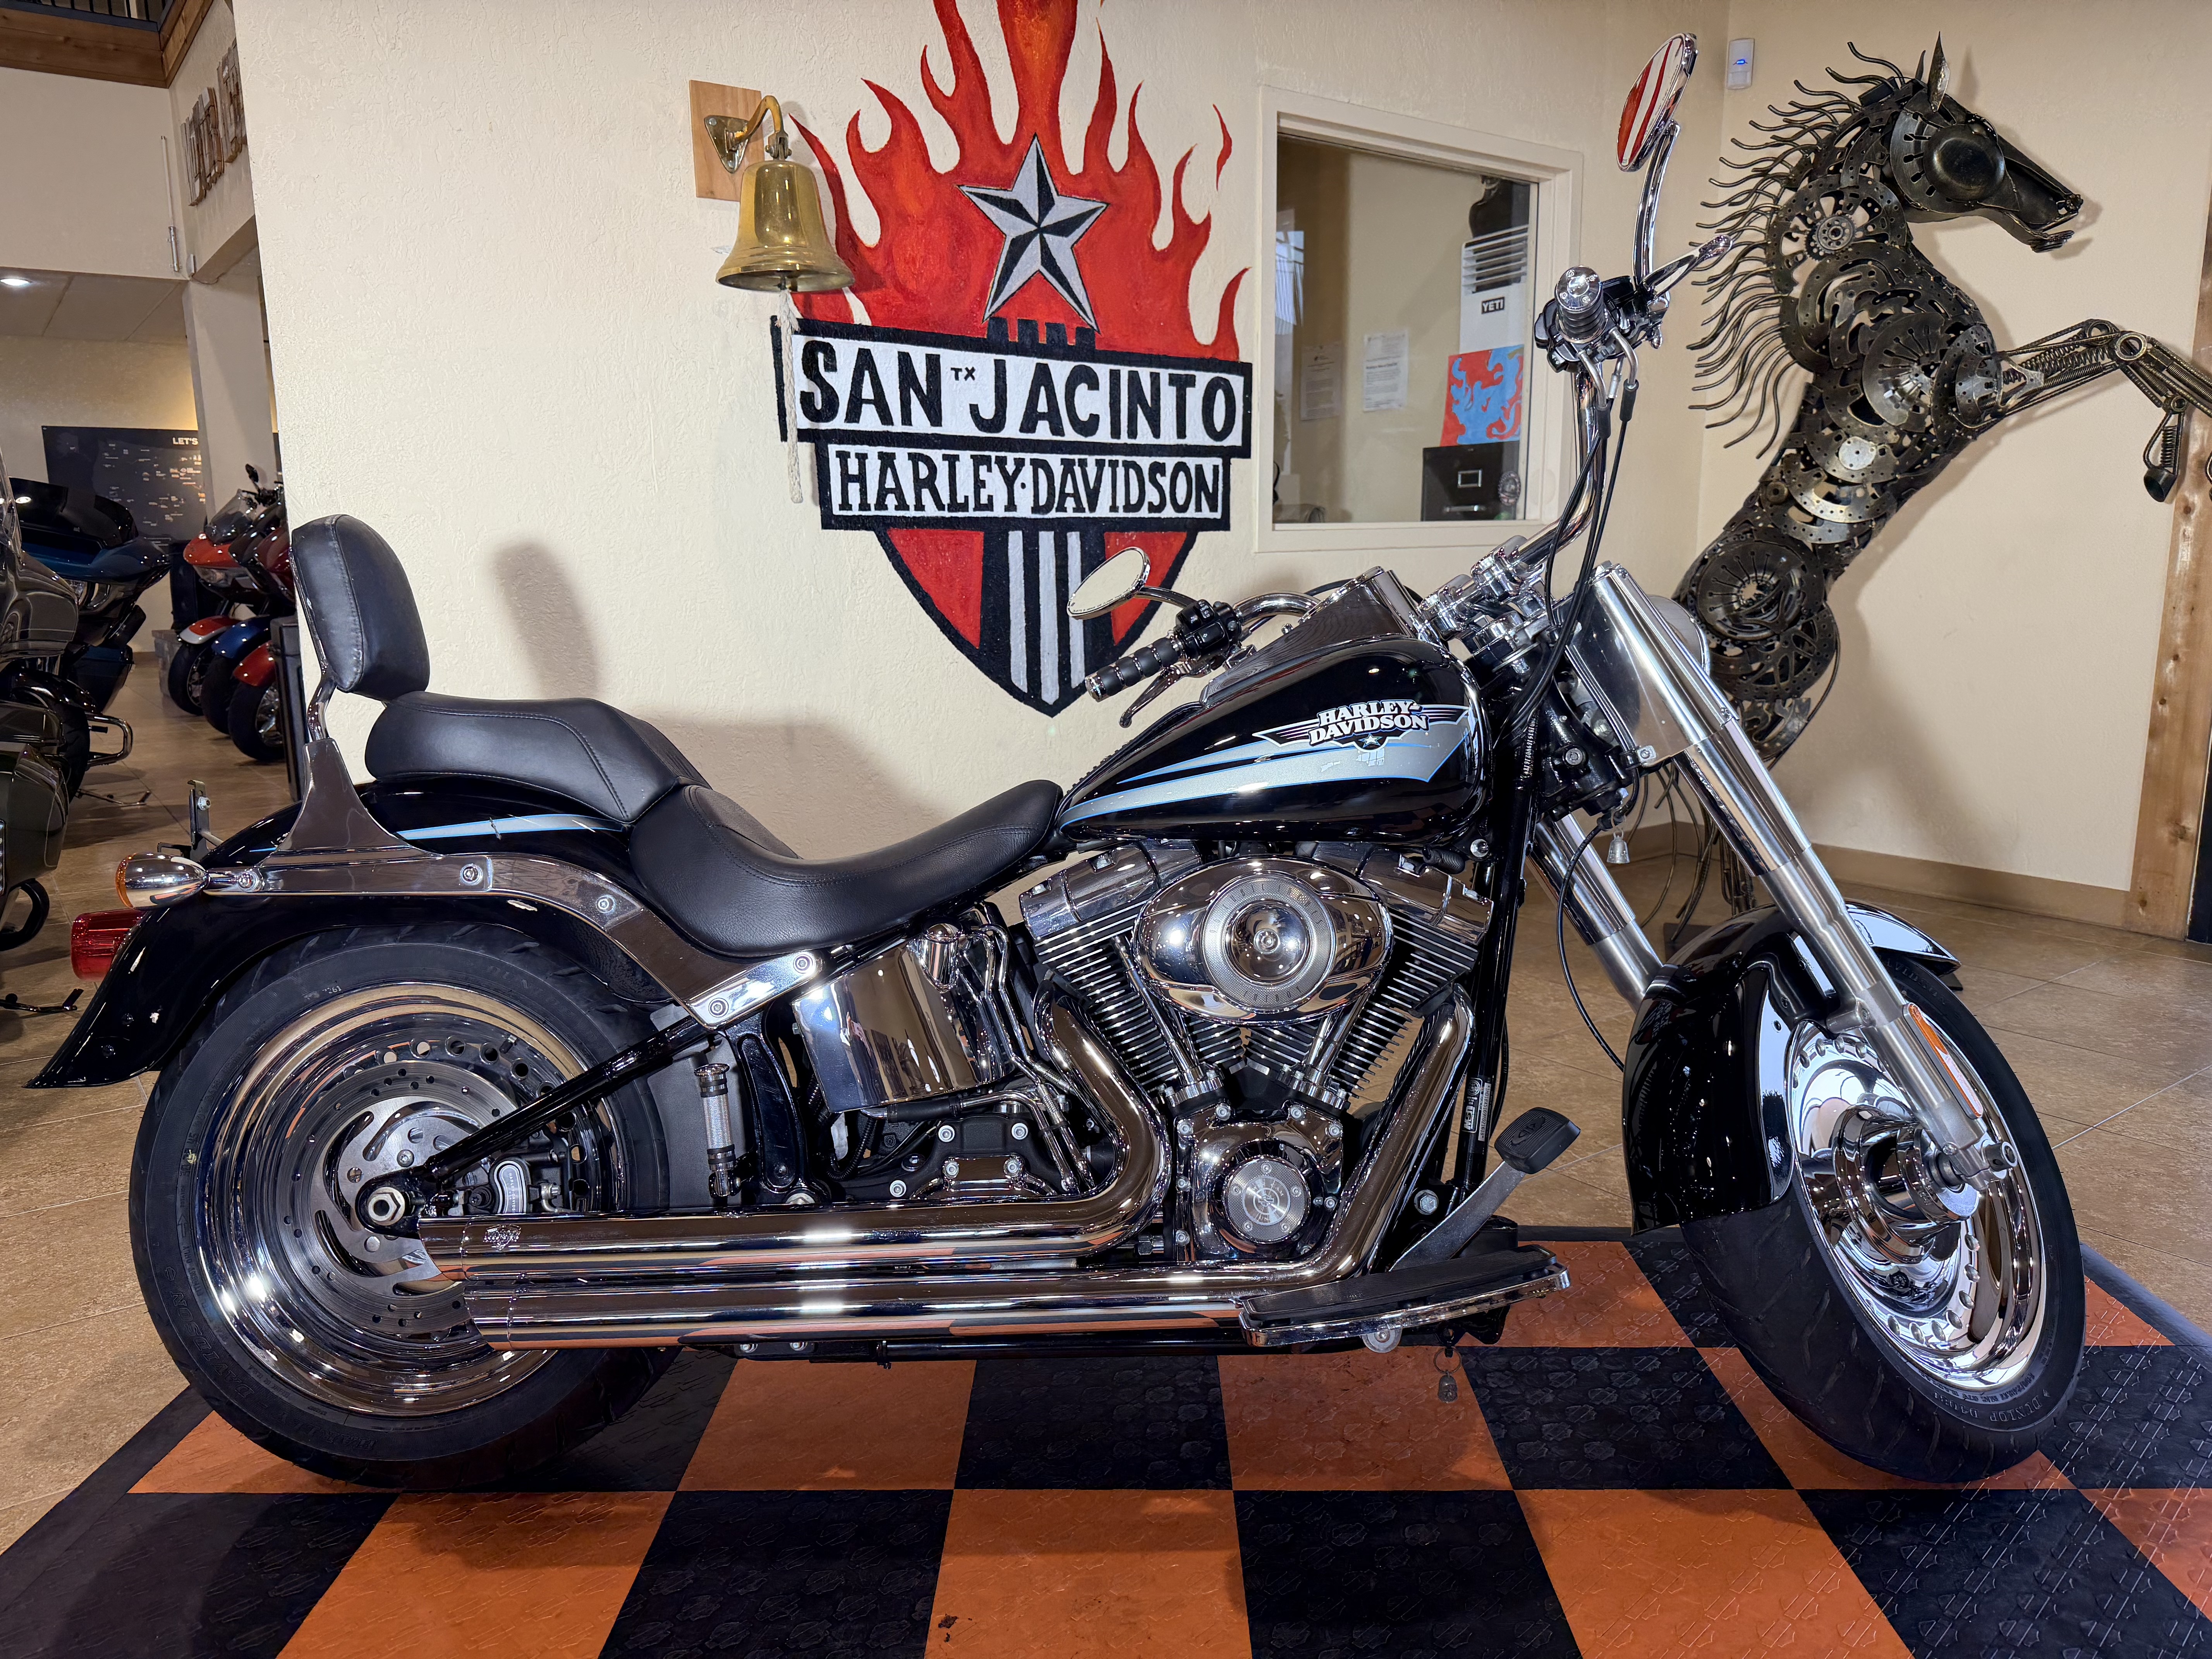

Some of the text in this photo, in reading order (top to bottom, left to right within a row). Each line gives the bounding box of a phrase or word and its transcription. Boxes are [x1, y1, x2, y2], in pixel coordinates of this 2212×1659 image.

[1482, 298, 1504, 313] YETI
[800, 340, 943, 428] SAN
[950, 367, 975, 382] TX
[969, 359, 1237, 442] JACINTO
[172, 437, 199, 445] LET'S
[1309, 714, 1428, 745] DAVIDSON
[1277, 883, 1324, 925] INHES
[1989, 1395, 2043, 1422] DUNLOP
